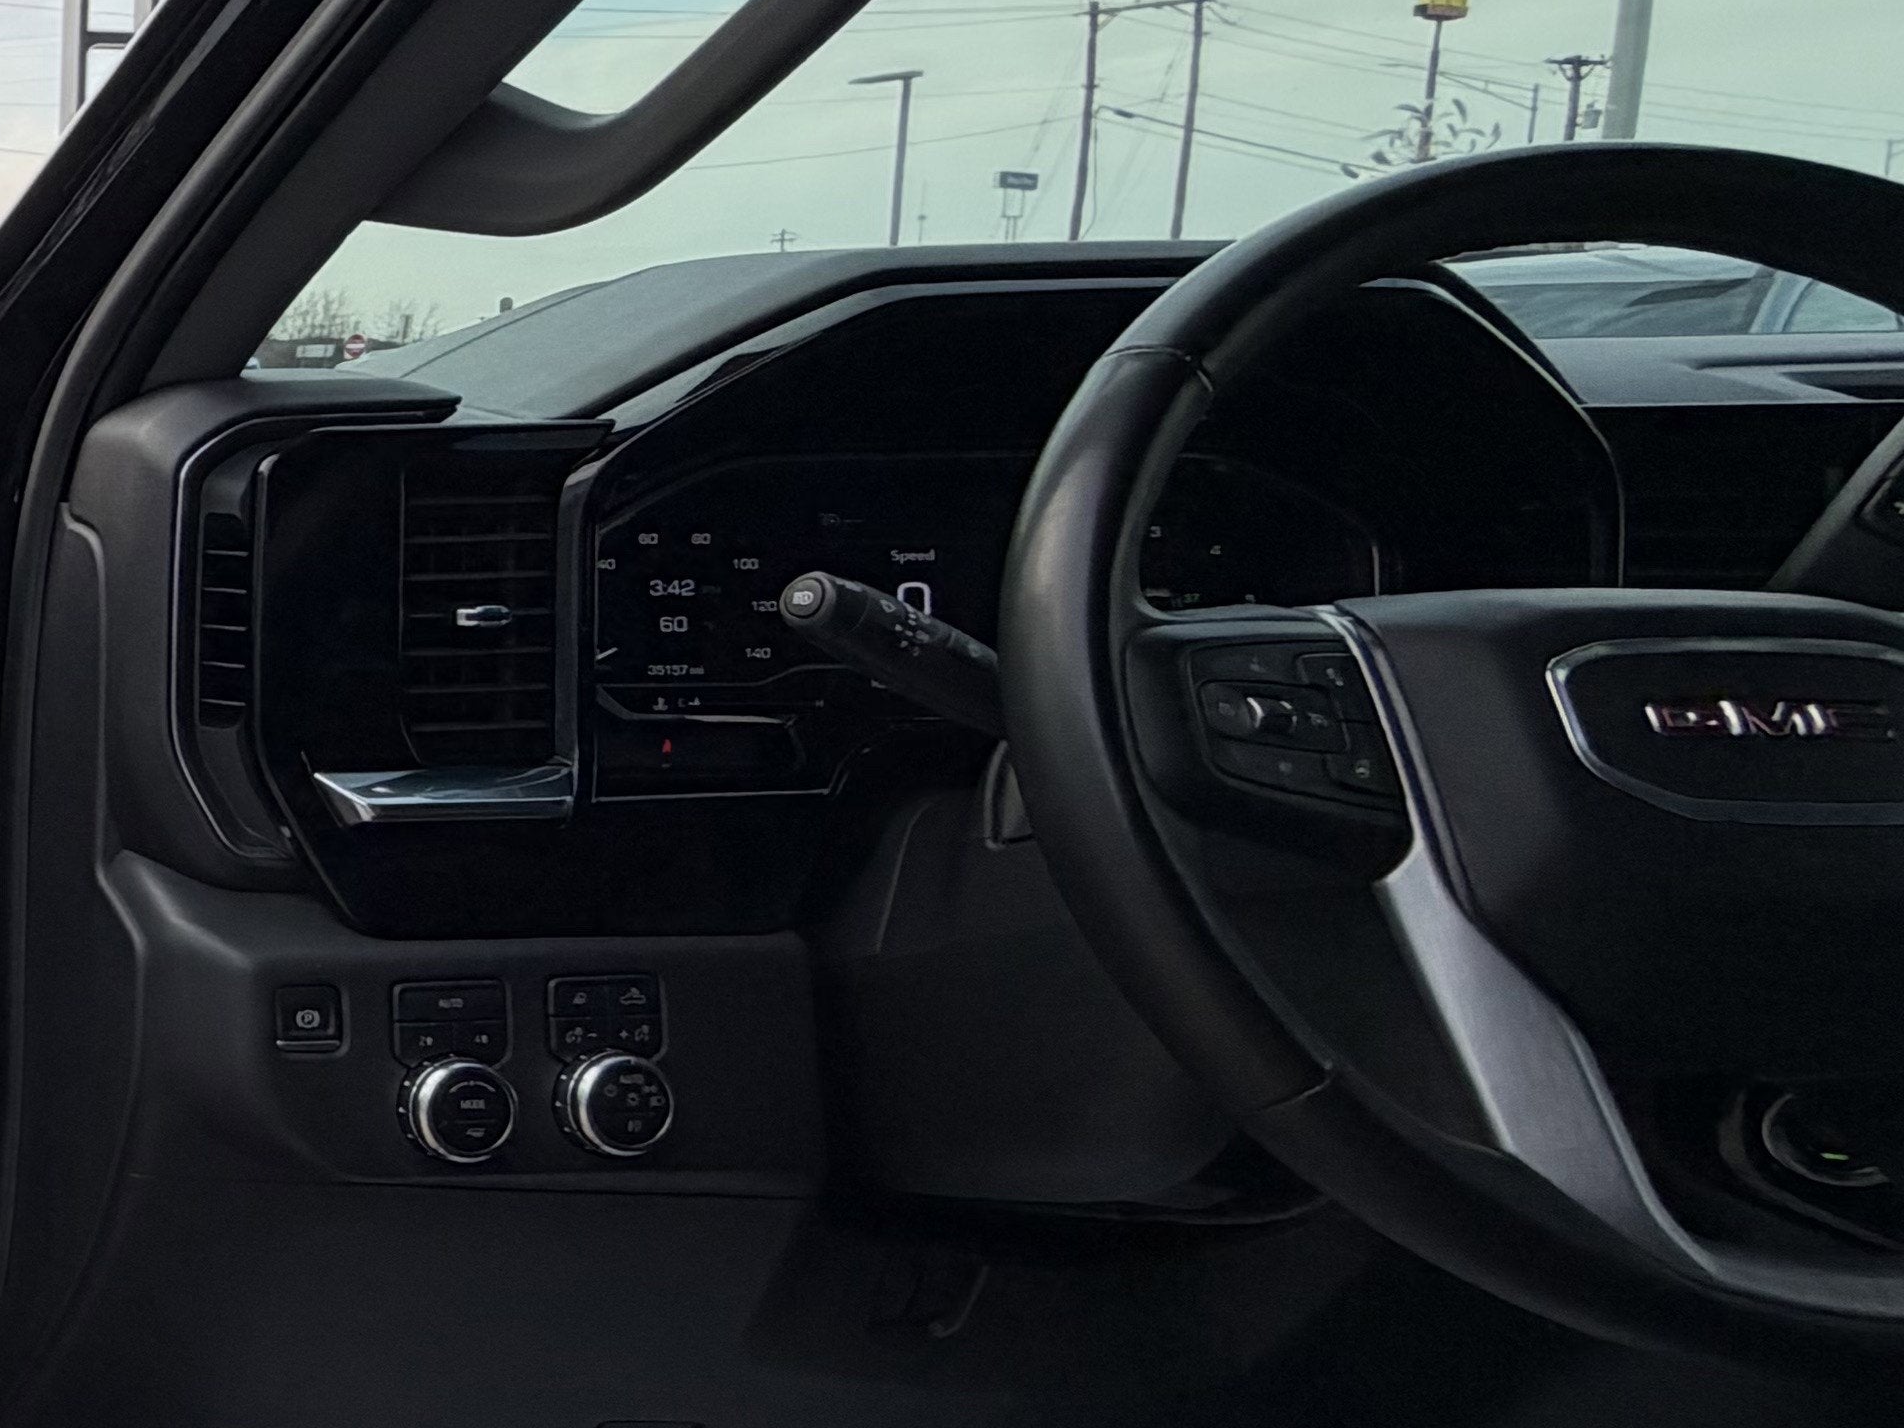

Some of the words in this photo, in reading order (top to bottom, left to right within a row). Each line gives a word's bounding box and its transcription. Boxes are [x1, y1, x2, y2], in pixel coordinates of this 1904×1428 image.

[732, 558, 760, 570] 100
[890, 548, 936, 565] Speed
[649, 578, 696, 597] 3:42
[659, 615, 689, 633] 60
[1644, 700, 1892, 737] GMC
